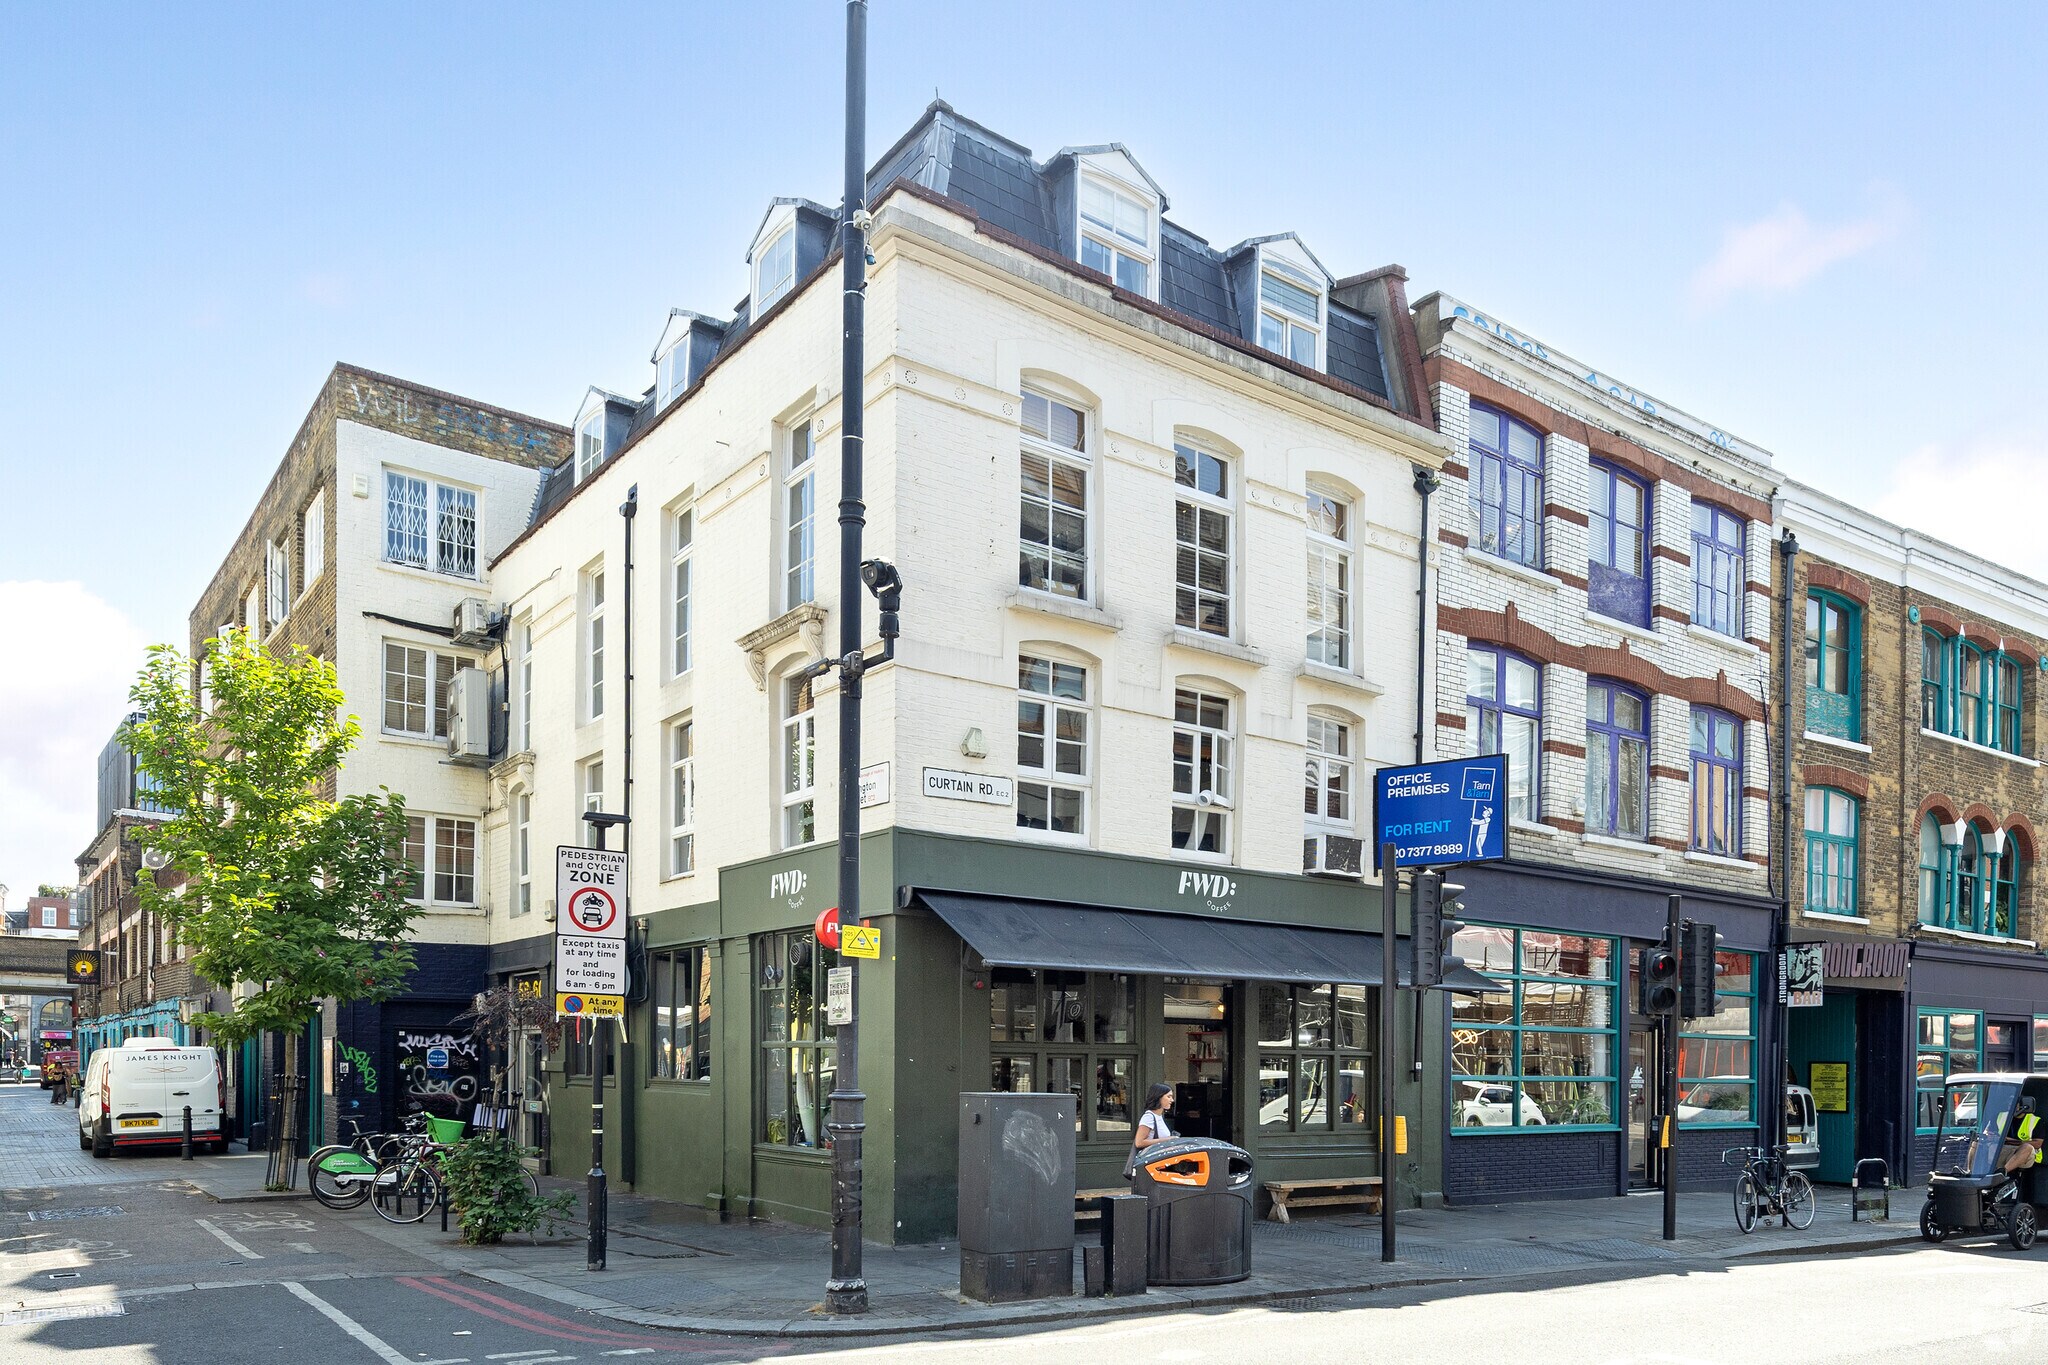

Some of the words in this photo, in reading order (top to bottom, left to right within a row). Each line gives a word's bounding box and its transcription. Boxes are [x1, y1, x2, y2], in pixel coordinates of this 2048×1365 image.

[928, 776, 973, 793] CURTAIN
[978, 783, 994, 796] RD.
[1387, 772, 1432, 787] OFFICE
[1472, 781, 1491, 790] Tarn
[1387, 783, 1450, 799] PREMISES
[1385, 823, 1412, 838] FOR
[1414, 820, 1452, 835] RENT
[561, 850, 625, 864] PEDESTRIAN
[1395, 848, 1406, 859] 20
[1407, 846, 1433, 858] 7377
[1433, 843, 1463, 856] 8989
[565, 861, 583, 870] and
[587, 862, 620, 872] CYCLE
[569, 870, 615, 885] ZONE
[770, 869, 807, 899] FWD:
[1178, 871, 1237, 898] FWD:
[1206, 900, 1232, 912] COFFEE
[562, 938, 594, 950] Except
[596, 940, 620, 950] taxis
[565, 948, 575, 956] at
[577, 950, 594, 959] any
[596, 949, 617, 959] time
[1804, 942, 1910, 978] RONGROOM
[566, 968, 579, 976] for
[582, 969, 616, 980] loading
[1778, 953, 1787, 1004] STRONGROOM
[829, 982, 850, 990] THIEVES
[829, 989, 850, 997] BEWARE
[588, 997, 600, 1005] At
[601, 998, 618, 1007] any
[1793, 991, 1821, 1006] BAR
[593, 1006, 613, 1014] time
[124, 1119, 140, 1127] BK71
